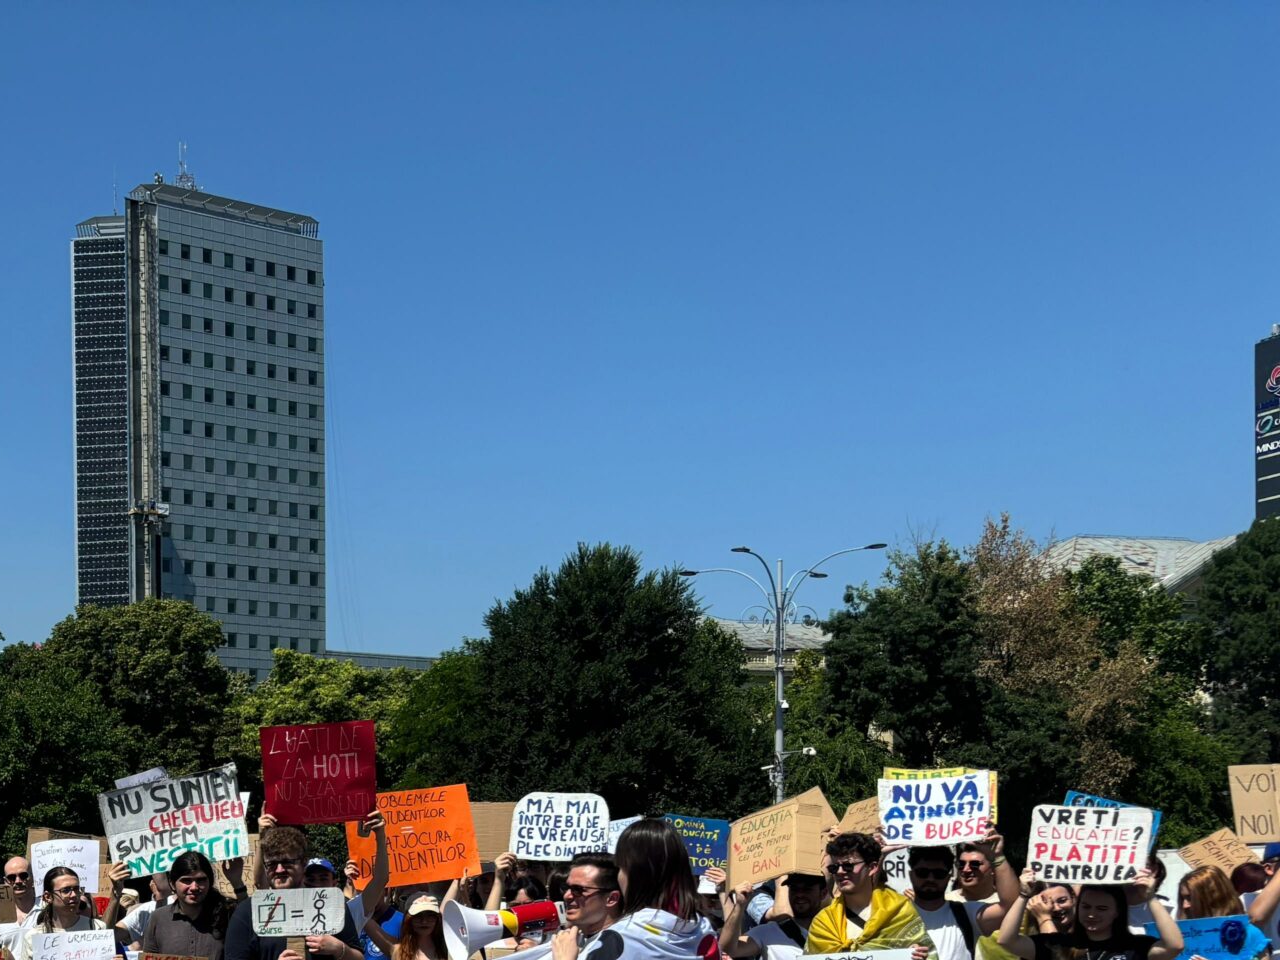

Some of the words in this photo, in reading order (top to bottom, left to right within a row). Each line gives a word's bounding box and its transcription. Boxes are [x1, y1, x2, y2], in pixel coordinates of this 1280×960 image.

[339, 725, 363, 751] DE
[282, 757, 307, 779] LA
[275, 782, 292, 801] NU
[892, 783, 932, 805] NU
[941, 774, 979, 801] VĂ
[107, 790, 144, 819] NU
[376, 790, 447, 809] ROBLEMELE
[526, 796, 555, 813] MĂ
[566, 800, 598, 814] MAI
[586, 815, 600, 829] DE
[886, 824, 913, 840] DE
[925, 816, 989, 841] BURSE
[1240, 809, 1275, 837] NOI
[116, 825, 200, 860] SUNTEM
[385, 829, 452, 851] ATJOCURA
[518, 826, 534, 840] CE
[538, 826, 589, 842] VREAU
[590, 827, 606, 843] SĂ
[742, 836, 753, 845] NU
[756, 828, 776, 841] ESTE
[765, 833, 791, 847] PENTRU
[516, 840, 551, 857] PLEC
[752, 849, 764, 859] CU
[1202, 840, 1235, 869] ECHITA
[690, 856, 728, 868] TORIE
[1031, 861, 1109, 880] PENTRU
[1113, 865, 1138, 880] EA
[43, 936, 61, 950] CE
